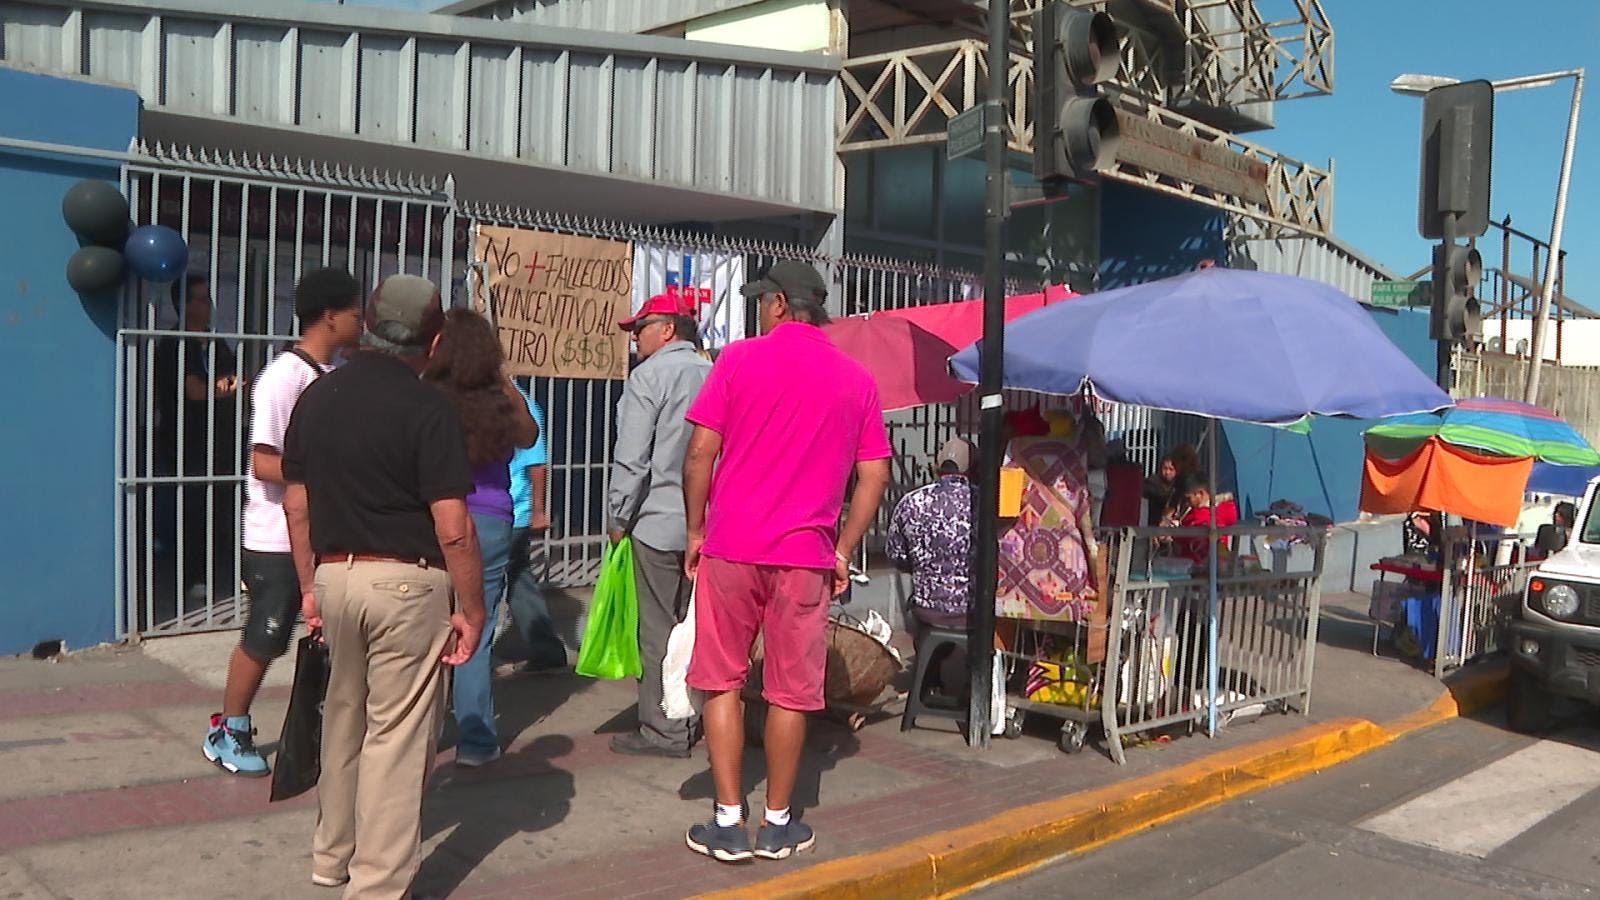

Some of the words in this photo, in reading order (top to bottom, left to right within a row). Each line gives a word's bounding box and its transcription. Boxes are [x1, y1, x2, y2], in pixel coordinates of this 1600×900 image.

[544, 254, 630, 297] FALLECIDOS
[510, 287, 598, 335] INCENTIVO
[595, 300, 616, 336] AL
